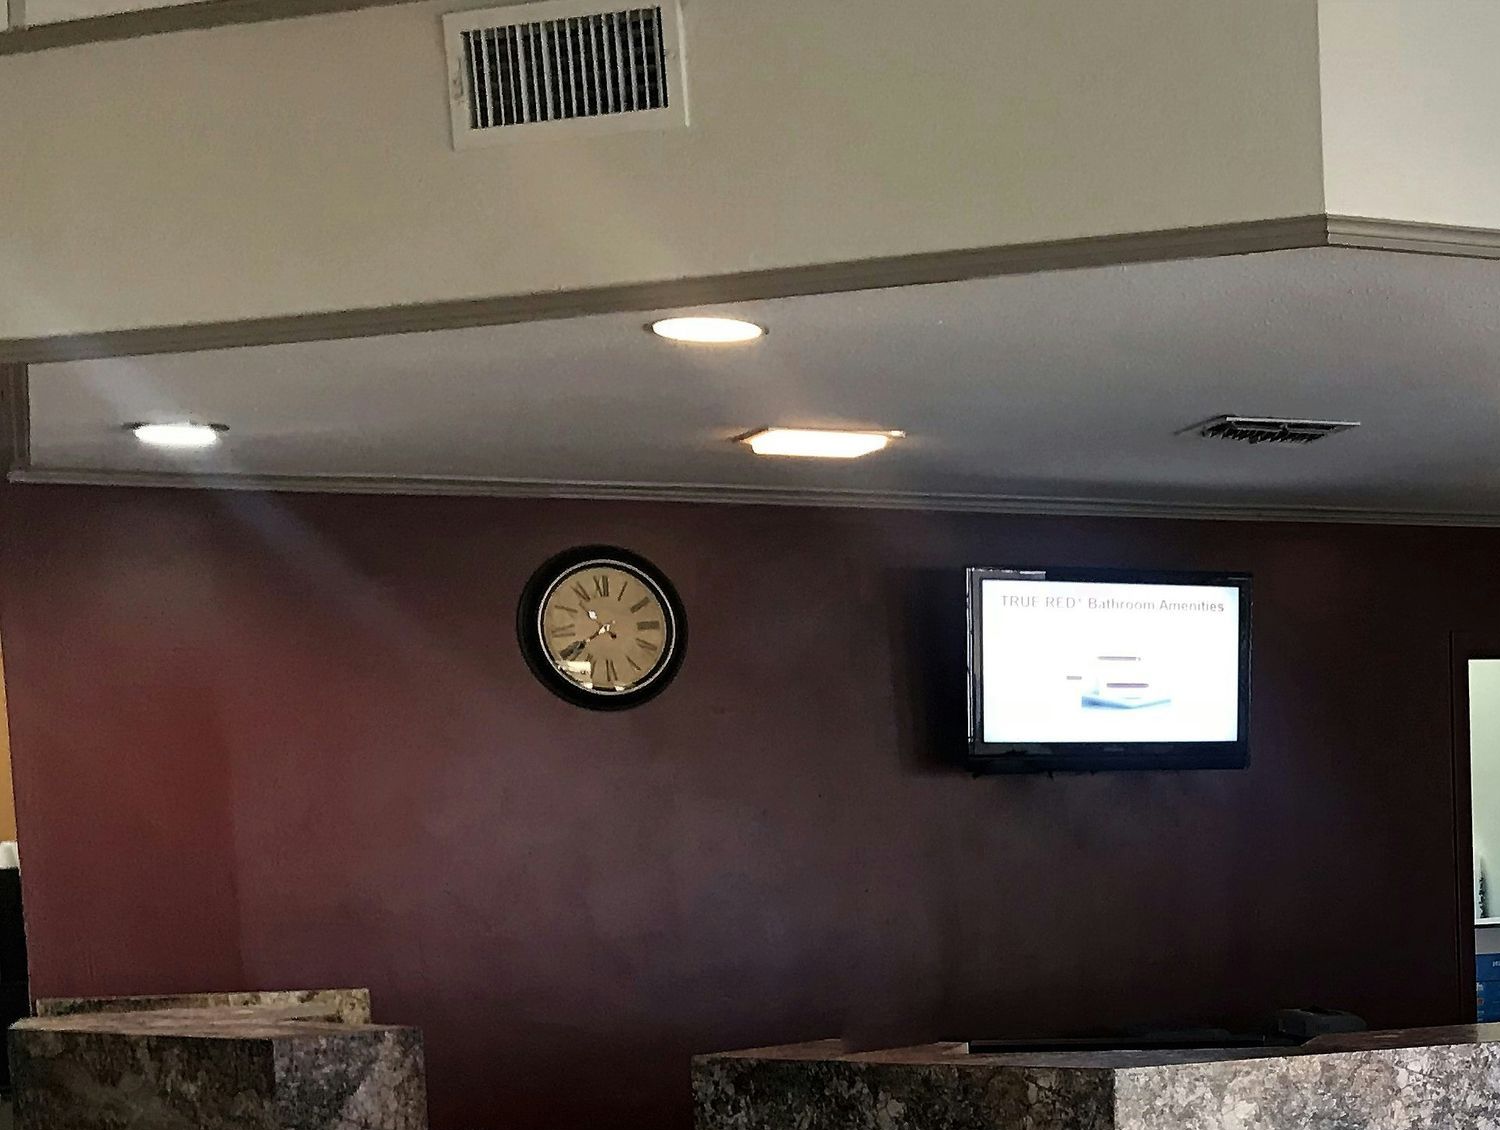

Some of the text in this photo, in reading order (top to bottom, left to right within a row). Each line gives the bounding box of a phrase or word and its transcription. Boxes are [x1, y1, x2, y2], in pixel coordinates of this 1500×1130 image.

[1001, 595, 1040, 608] TRUE
[1088, 597, 1155, 610] Bathroom
[1159, 599, 1225, 612] Amenities
